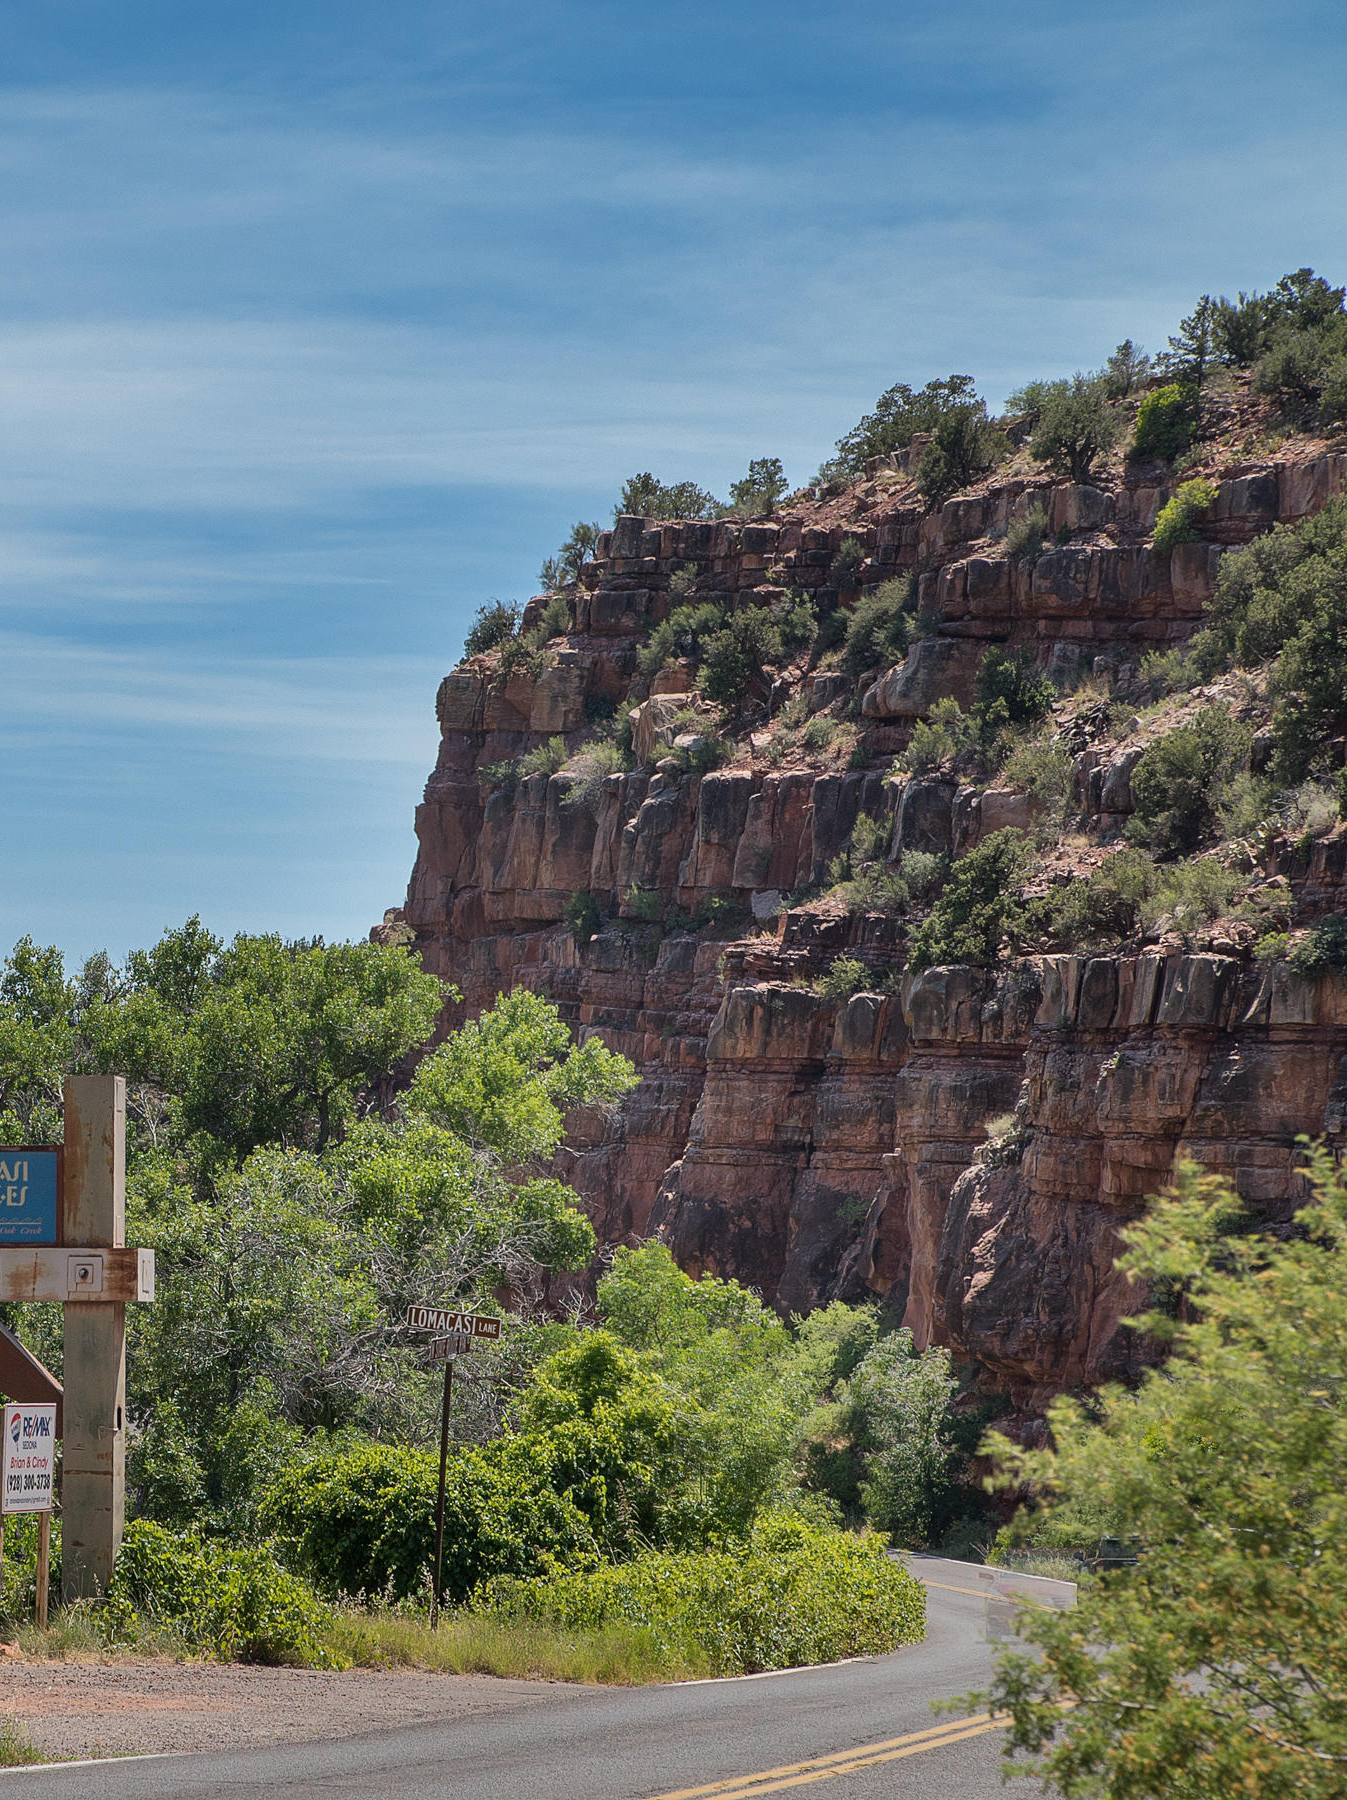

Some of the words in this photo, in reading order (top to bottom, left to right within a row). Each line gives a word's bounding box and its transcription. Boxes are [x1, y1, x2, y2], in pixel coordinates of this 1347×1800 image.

[0, 1226, 16, 1235] Oak
[20, 1226, 42, 1235] Creek
[410, 1308, 476, 1335] LOMACASI
[478, 1322, 497, 1334] LANE
[23, 1414, 51, 1439] RE/MAX
[10, 1456, 25, 1468] Brian
[26, 1456, 31, 1468] &
[32, 1456, 49, 1470] Cindy
[6, 1474, 22, 1493] (928)
[23, 1473, 50, 1490] 300-3738
